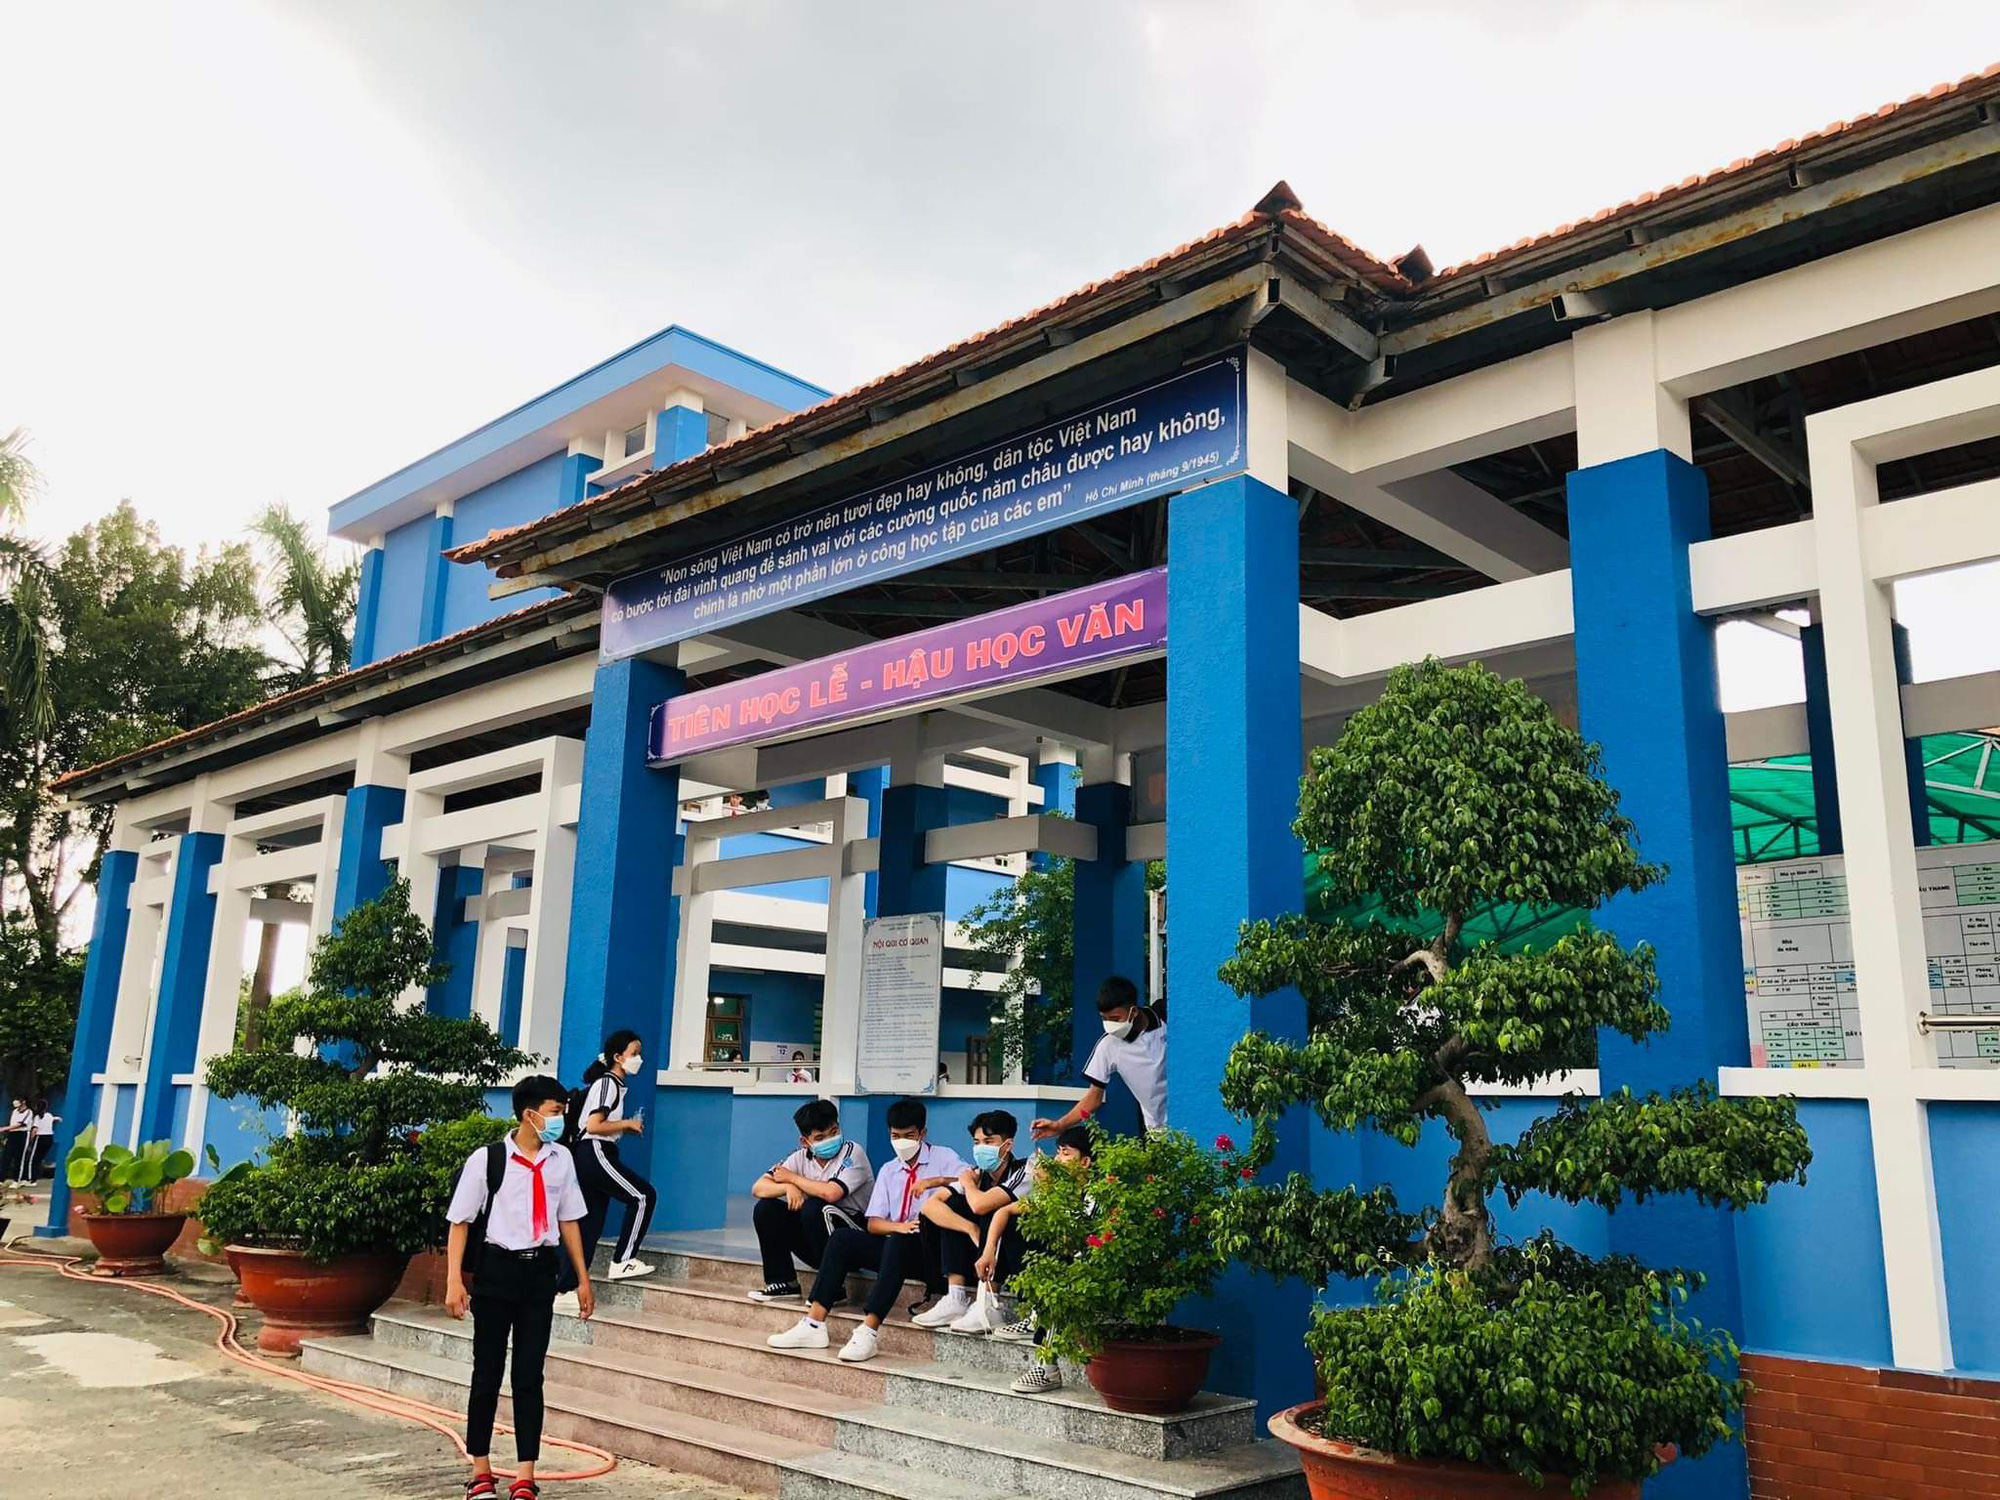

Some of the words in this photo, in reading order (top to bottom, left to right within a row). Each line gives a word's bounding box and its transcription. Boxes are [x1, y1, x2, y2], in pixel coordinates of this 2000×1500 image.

[611, 607, 624, 623] có
[626, 597, 654, 619] bước
[656, 588, 672, 609] tới
[674, 584, 691, 604] đài
[694, 576, 717, 597] vinh
[720, 565, 757, 591] quang
[760, 552, 775, 576] để
[778, 545, 808, 569] sánh
[811, 536, 830, 558] vai
[834, 528, 856, 550] với
[859, 521, 883, 542] các
[887, 505, 935, 534] cường
[939, 486, 978, 519] quốc
[982, 478, 1016, 503] năm
[1021, 462, 1062, 489] châu
[1066, 444, 1115, 474] được
[1120, 430, 1153, 456] hay
[1158, 407, 1226, 443] không,
[660, 568, 687, 585] “Non
[690, 556, 718, 577] sông
[721, 545, 743, 566] Việt
[745, 537, 772, 558] Nam
[775, 526, 791, 547] có
[793, 519, 813, 540] trở
[815, 512, 840, 533] nên
[843, 498, 873, 523] tươi
[875, 491, 902, 513] đẹp
[906, 481, 932, 502] hay
[936, 461, 989, 492] không,
[993, 447, 1022, 471] dân
[1027, 437, 1054, 461] tộc
[1059, 420, 1092, 448] Việt
[1096, 407, 1137, 435] Nam
[693, 596, 725, 620] chính
[727, 591, 738, 609] là
[741, 582, 766, 605] nhờ
[768, 575, 792, 596] một
[795, 561, 827, 592] phần
[830, 555, 853, 577] lớn
[857, 550, 868, 568] ở
[871, 540, 907, 563] công
[910, 530, 938, 553] học
[942, 521, 966, 544] tập
[970, 509, 999, 533] của
[1003, 499, 1032, 522] các
[1037, 483, 1071, 512] em”
[668, 703, 731, 742] TIÊN
[739, 687, 801, 726] HỌC
[809, 662, 849, 708] LỄ
[883, 648, 954, 691] HẬU
[966, 625, 1046, 670] HỌC
[1056, 598, 1144, 648] VĂN
